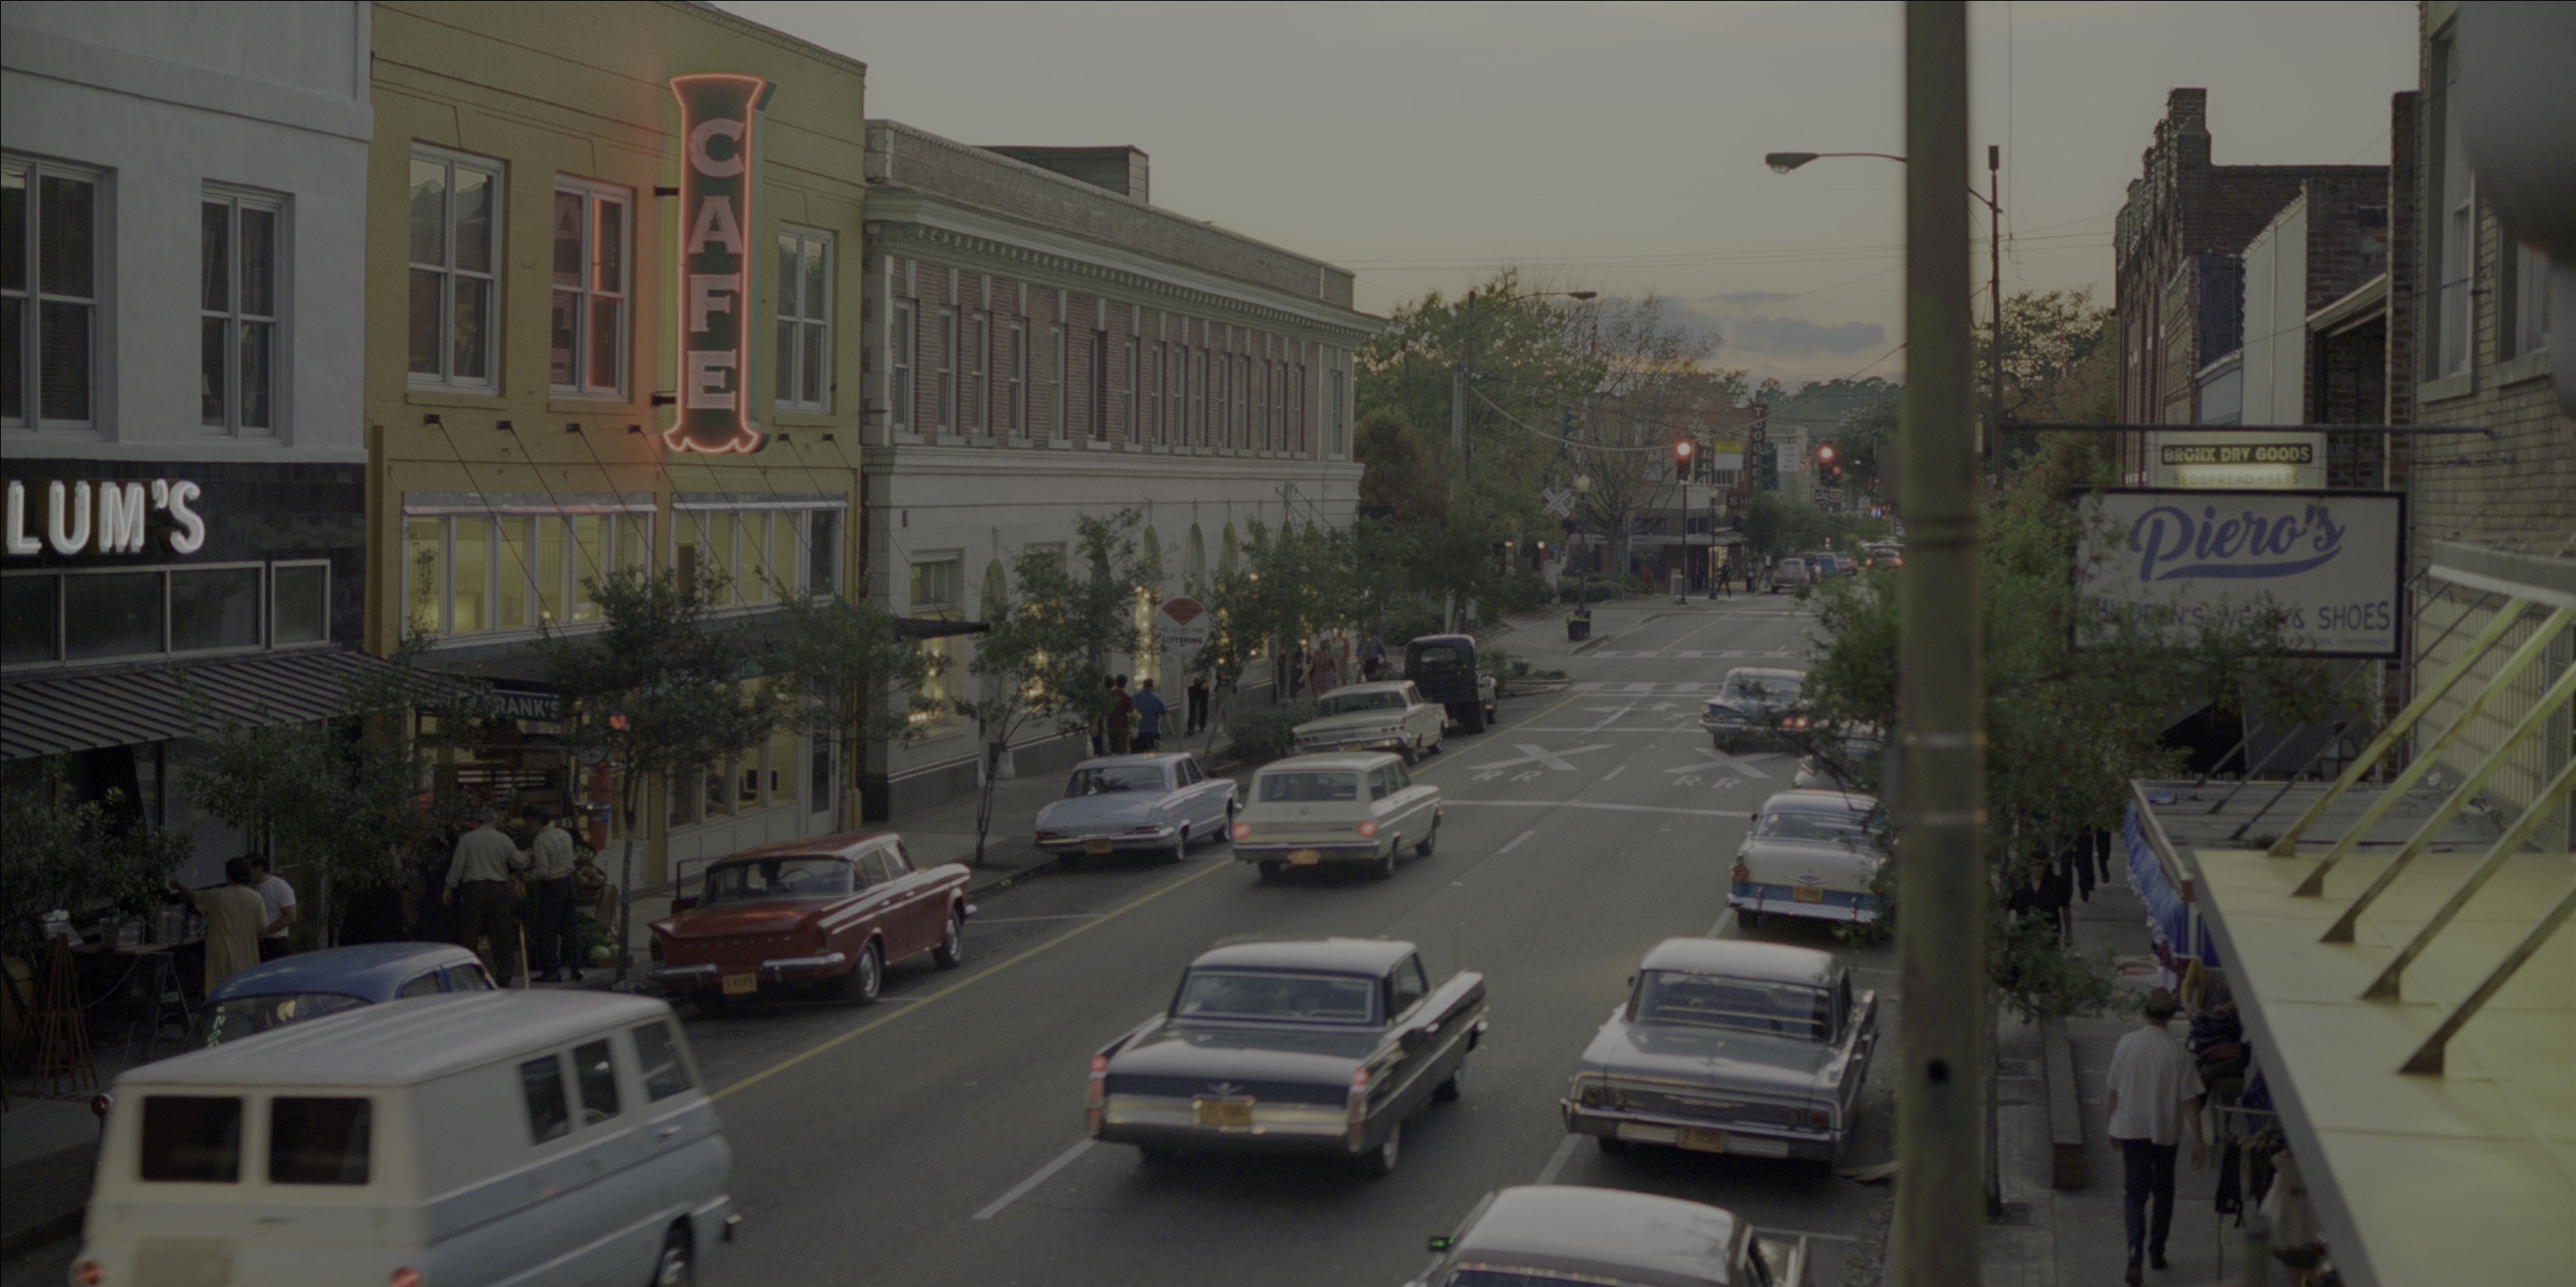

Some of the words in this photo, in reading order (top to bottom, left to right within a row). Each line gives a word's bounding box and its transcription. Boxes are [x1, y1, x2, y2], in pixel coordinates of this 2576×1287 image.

[686, 117, 746, 411] CAFE
[2163, 448, 2216, 462] BRONX
[2220, 448, 2250, 462] DRY
[2255, 446, 2310, 461] GOODS
[2173, 473, 2254, 485] BEDSPREAD
[2267, 472, 2299, 484] SETS
[6, 477, 206, 556] LUM'S
[2128, 503, 2346, 582] Piero's
[2217, 607, 2285, 629] WEA
[2291, 607, 2306, 629] &
[2318, 601, 2391, 631] SHOES
[1471, 770, 1504, 782] R
[1509, 770, 1542, 782] R
[1673, 774, 1702, 786] R
[1712, 777, 1742, 789] R
